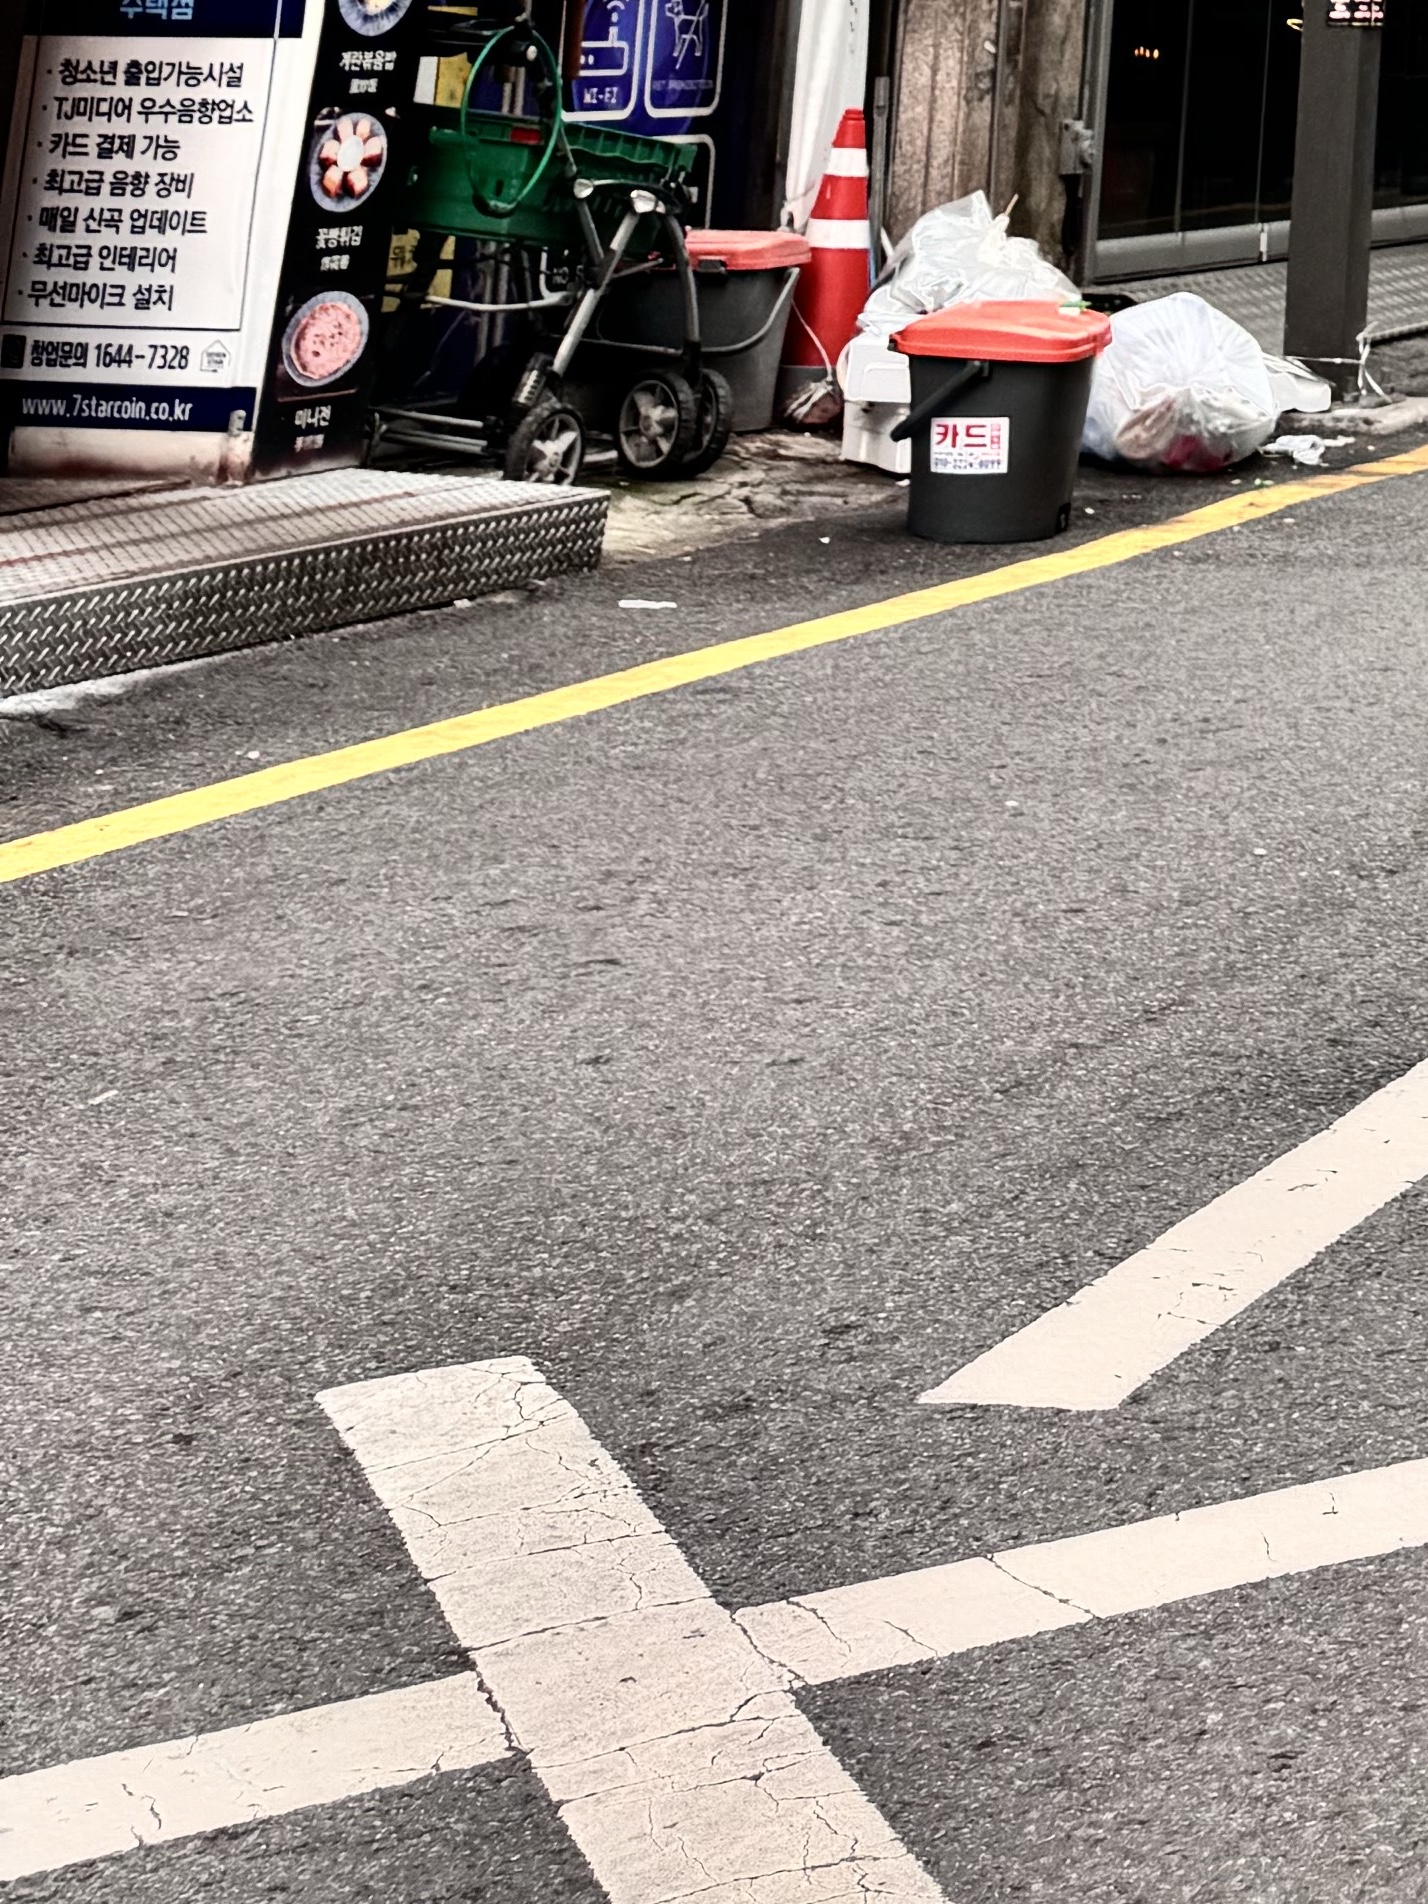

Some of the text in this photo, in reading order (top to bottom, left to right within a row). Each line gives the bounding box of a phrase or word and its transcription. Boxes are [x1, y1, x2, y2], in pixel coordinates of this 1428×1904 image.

[58, 58, 243, 89] 청소년 출입가능시설
[54, 95, 254, 125] TJ미디어 우수음향업소
[48, 133, 181, 161] 카드 결제 가능
[43, 169, 193, 199] 최고급 음향 장비
[39, 205, 207, 236] 매일 신곡 업데이트
[33, 242, 178, 274] 최고급 인테리어
[27, 280, 174, 312] 무선마이크 설치
[29, 342, 189, 371] 창업문의 1644-7328
[22, 394, 193, 422] www.7starcoin.co.kr
[935, 421, 988, 449] 카드
